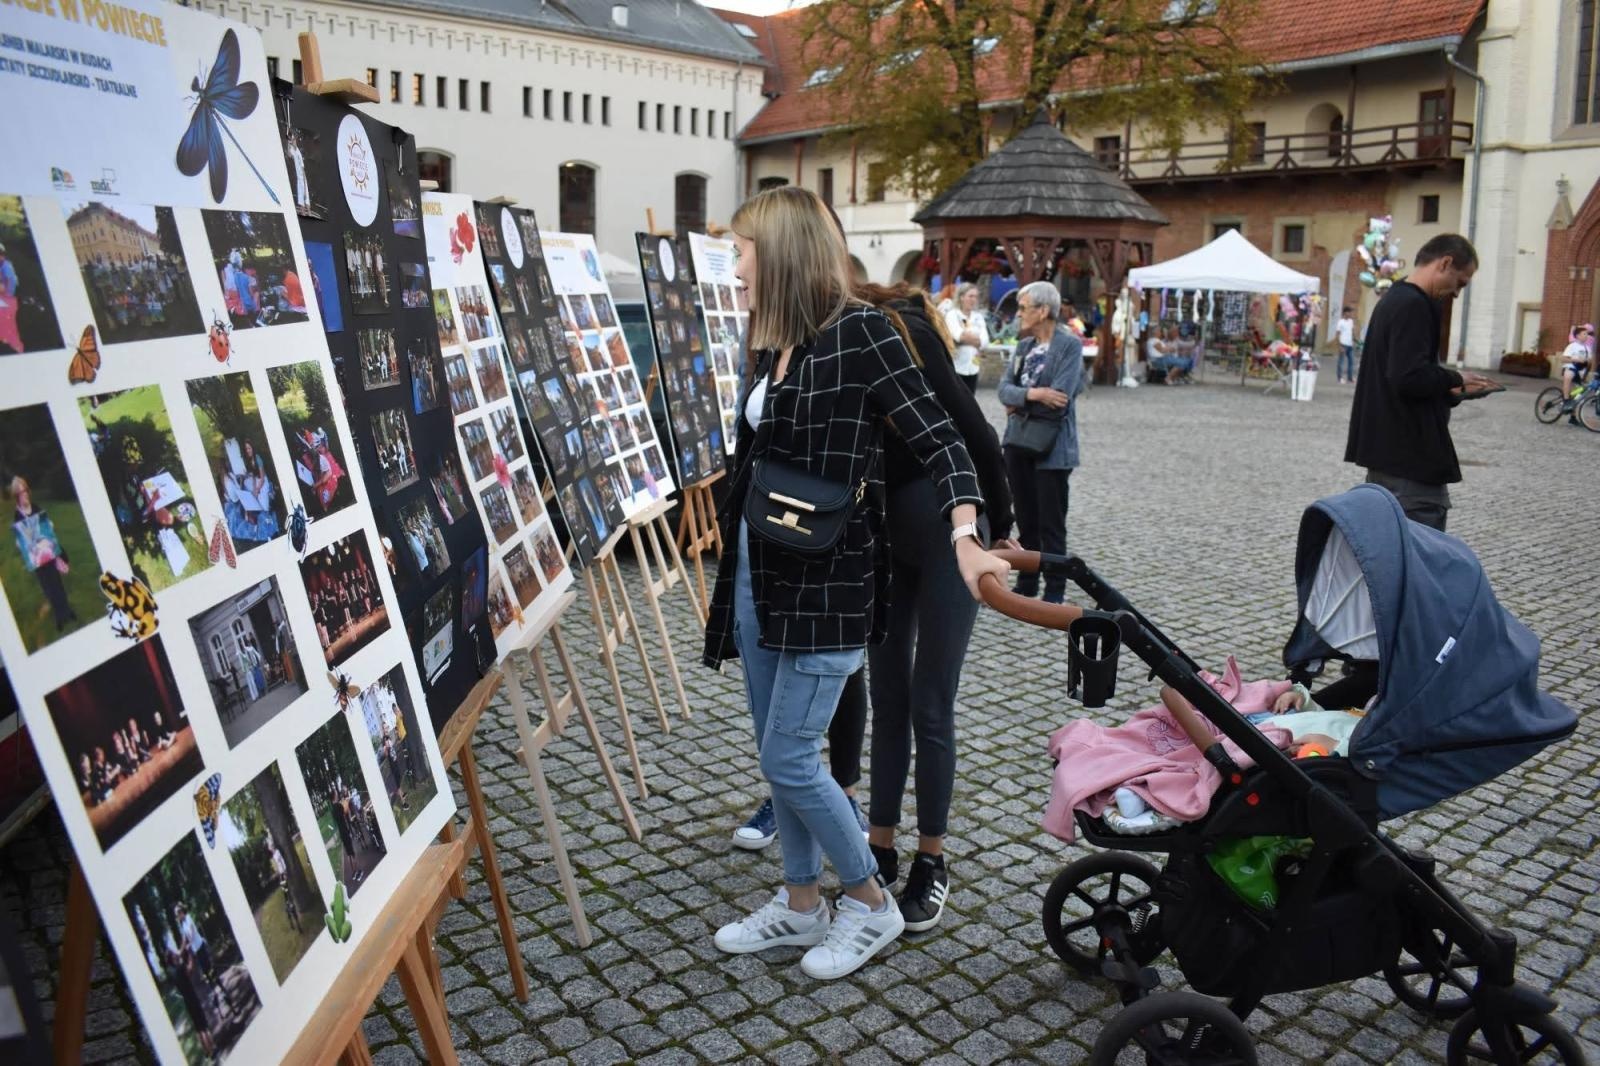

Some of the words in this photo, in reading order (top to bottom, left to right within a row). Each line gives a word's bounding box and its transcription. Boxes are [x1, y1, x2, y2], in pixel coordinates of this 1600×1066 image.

[57, 0, 79, 23] W
[82, 0, 168, 47] POWIECIE
[26, 39, 69, 62] MALARSKI
[80, 52, 112, 71] RUDACH
[95, 77, 138, 98] TEATRALNE
